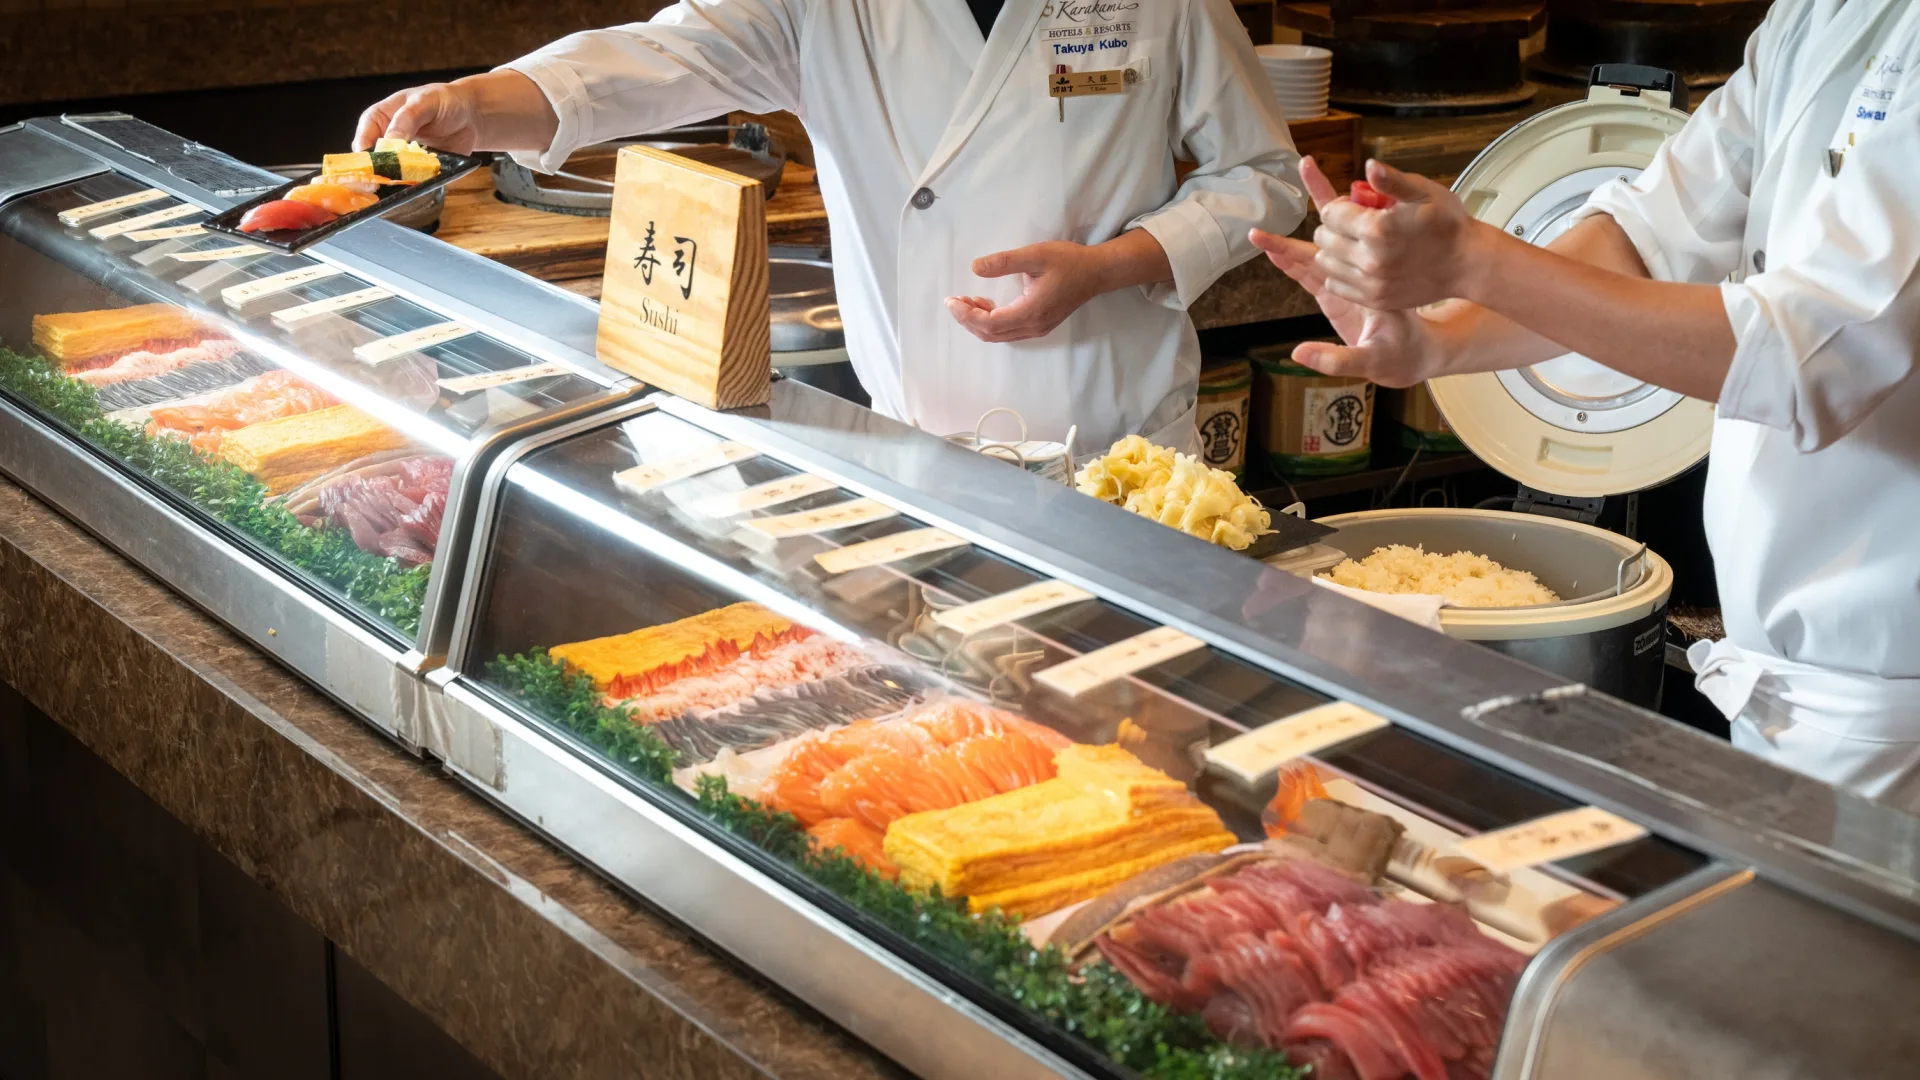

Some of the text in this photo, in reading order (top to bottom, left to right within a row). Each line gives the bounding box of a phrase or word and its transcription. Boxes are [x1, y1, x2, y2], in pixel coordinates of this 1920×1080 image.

[1056, 0, 1139, 22] Karakami
[1049, 23, 1131, 38] HOTELS & RESORTS
[1053, 38, 1128, 55] Takuya Kubo
[634, 221, 697, 300] 寿司
[640, 297, 679, 335] Sushi
